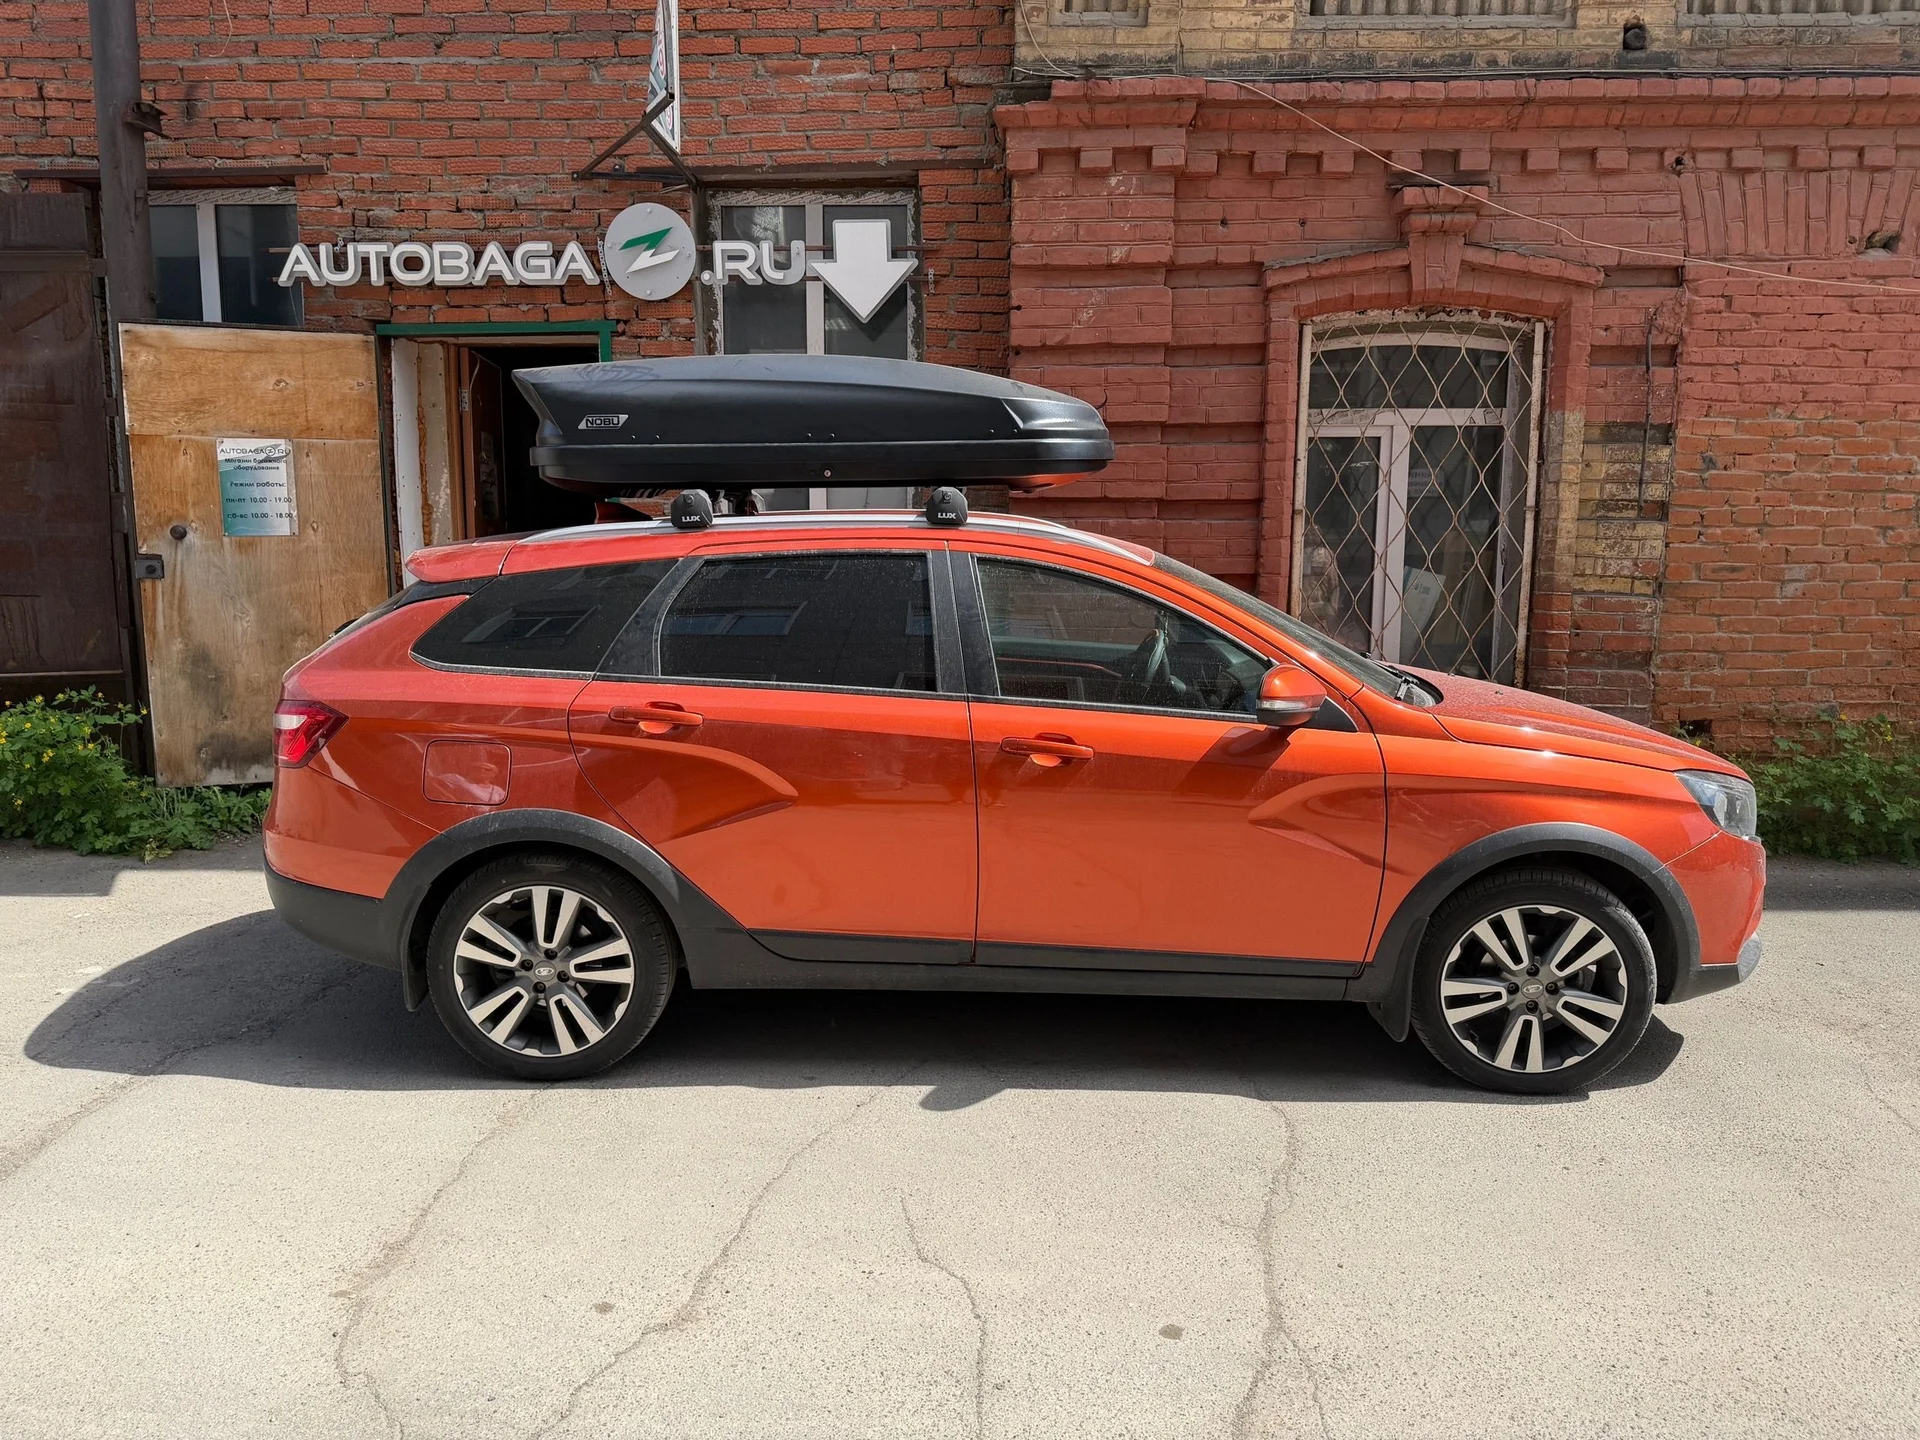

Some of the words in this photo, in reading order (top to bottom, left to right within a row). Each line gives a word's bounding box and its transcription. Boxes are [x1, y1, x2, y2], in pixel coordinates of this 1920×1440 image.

[278, 241, 600, 287] AUTOBAGA
[701, 240, 806, 286] .RU
[585, 416, 620, 428] NOBU
[249, 496, 268, 504] 10.00
[274, 496, 293, 504] 19.00
[681, 515, 701, 523] LUX
[937, 512, 957, 520] LUX
